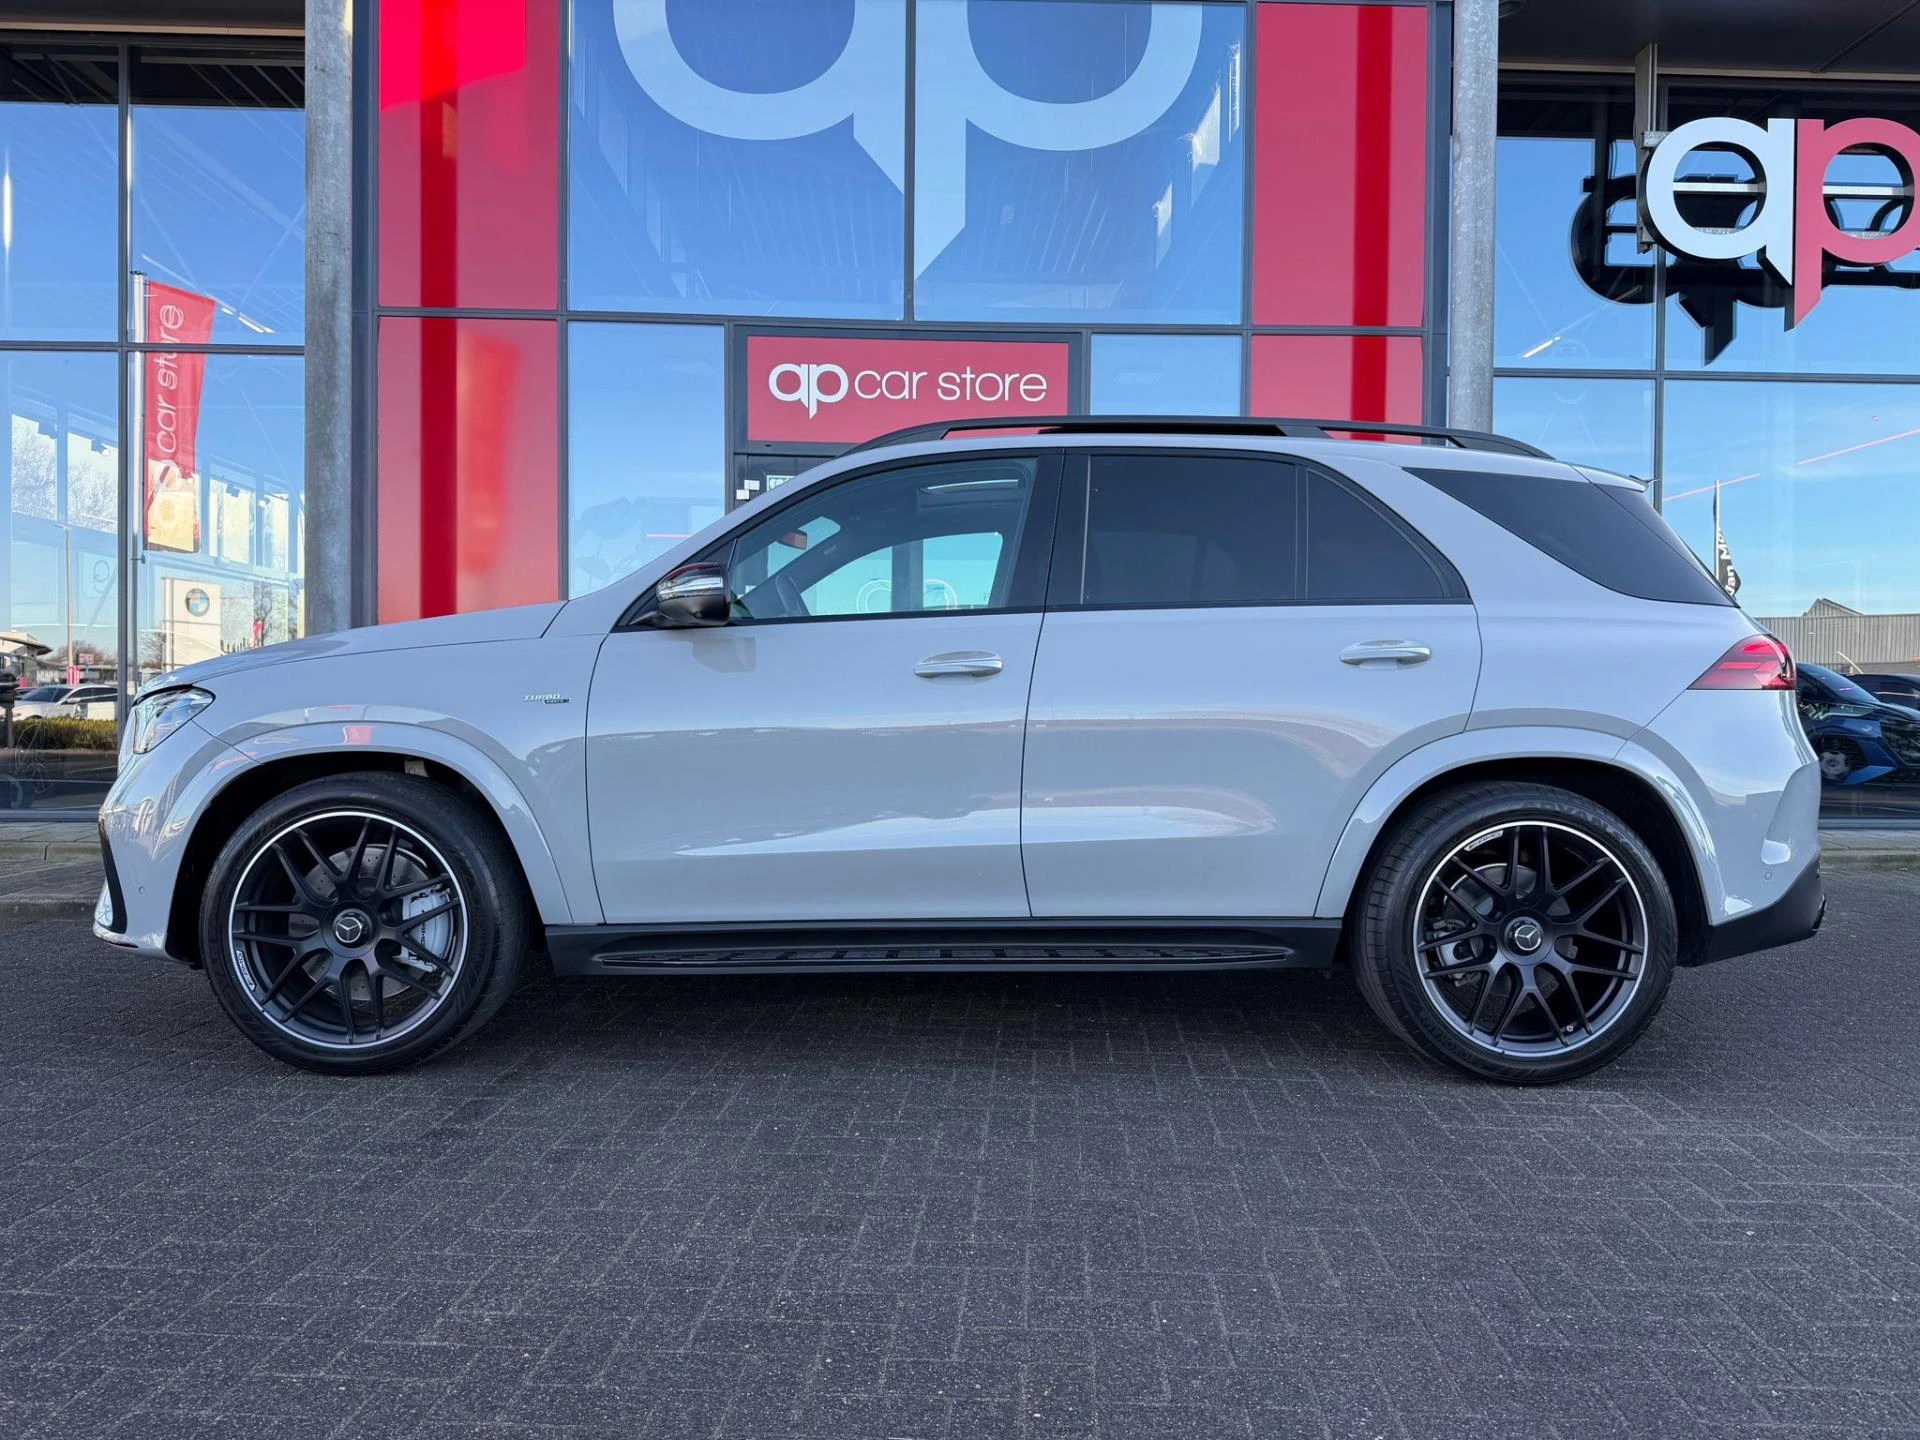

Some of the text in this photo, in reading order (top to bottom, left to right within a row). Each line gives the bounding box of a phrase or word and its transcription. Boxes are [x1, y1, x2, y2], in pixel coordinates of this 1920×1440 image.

[1644, 117, 1920, 329] ap
[768, 363, 1048, 419] ap car store
[156, 394, 177, 453] car
